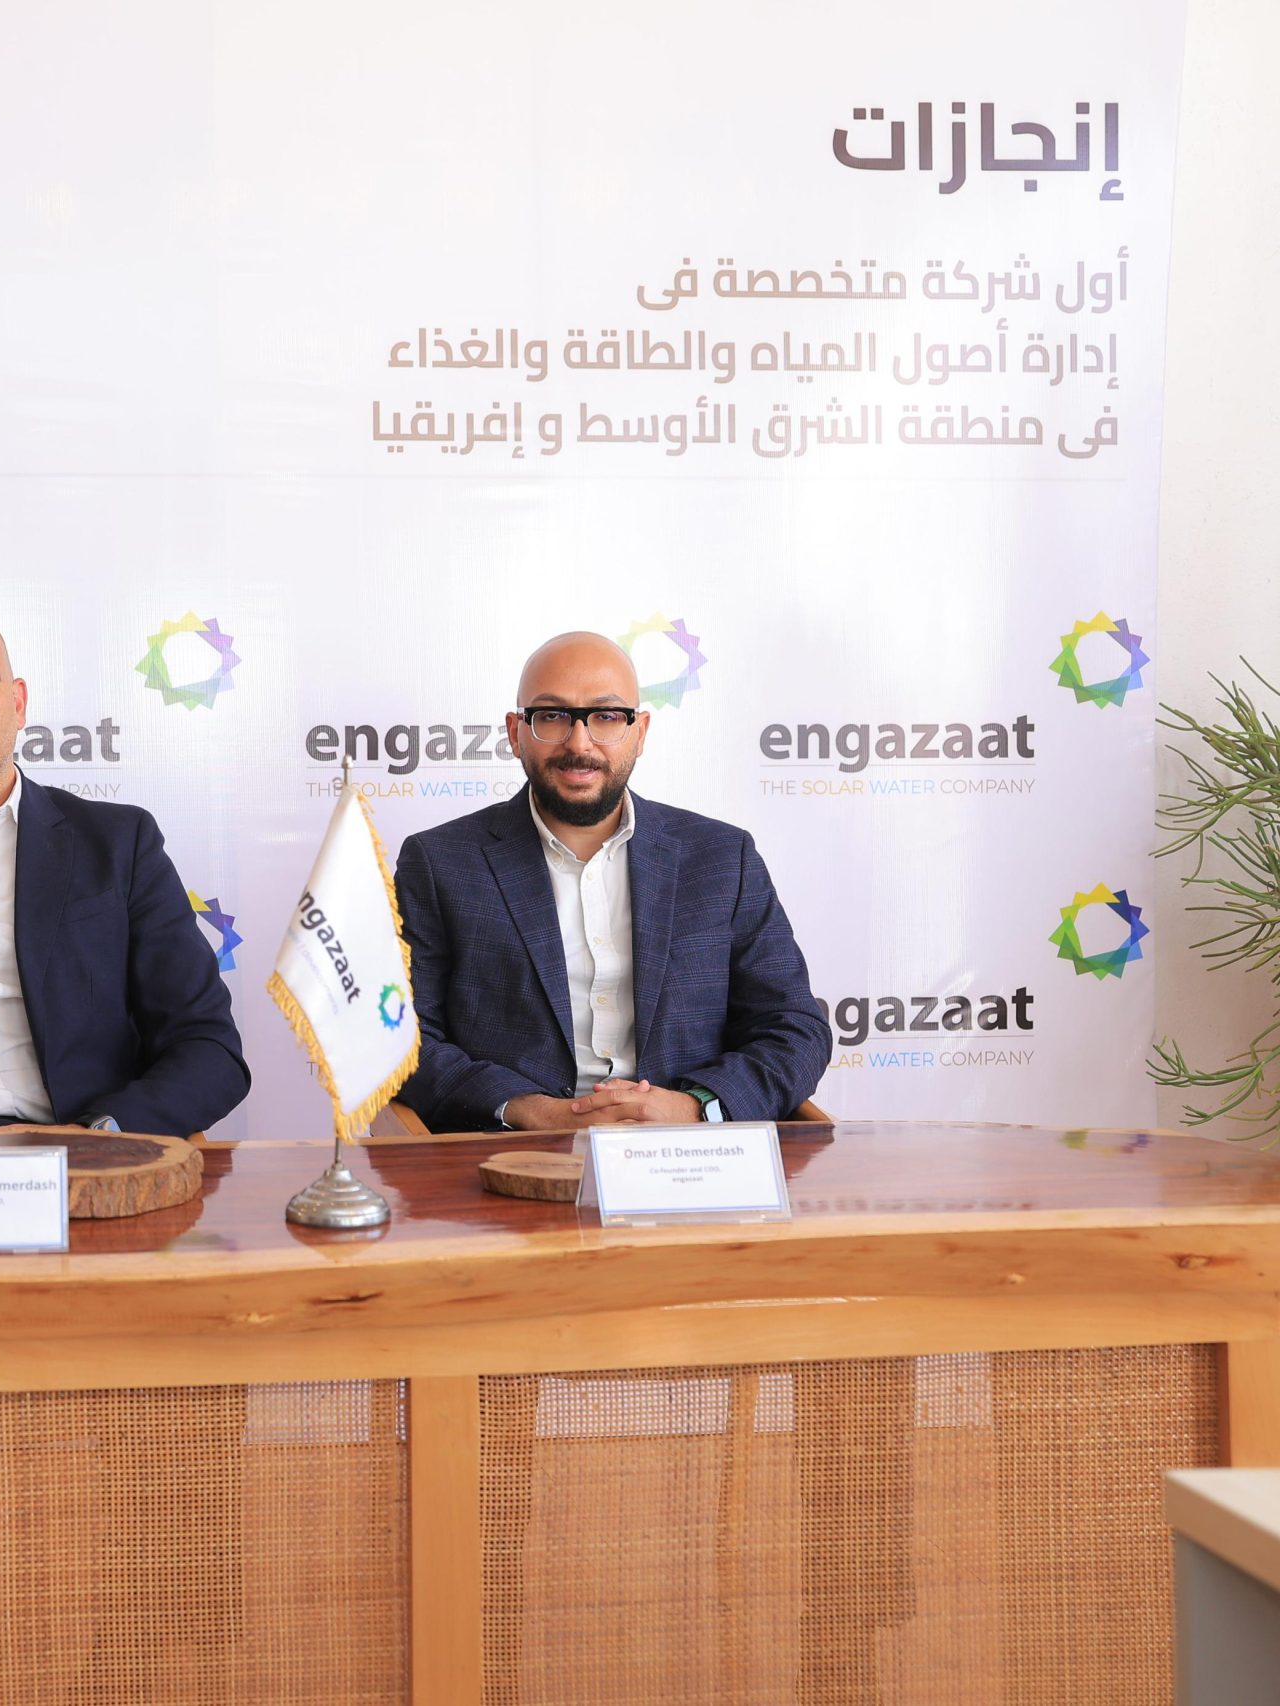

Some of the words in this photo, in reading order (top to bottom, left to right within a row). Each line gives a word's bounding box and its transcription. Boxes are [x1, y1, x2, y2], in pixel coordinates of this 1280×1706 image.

[832, 102, 1123, 200] إنجازات
[713, 258, 906, 299] متخصصة
[922, 253, 1040, 314] شركة
[1056, 245, 1129, 314] أول
[388, 328, 548, 382] والغذاء
[563, 329, 735, 384] والطاقة
[751, 331, 876, 383] المياه
[893, 317, 1008, 385] أصول
[1022, 333, 1119, 389] إدارة
[373, 401, 524, 459] إفريقيا
[577, 395, 736, 456] الأوسط
[752, 397, 882, 459] الشرق
[899, 405, 1043, 446] منطقة
[305, 724, 516, 775] engaz
[759, 715, 1035, 773] engazaat
[352, 782, 414, 797] OLAR
[419, 781, 487, 797] WATER
[760, 780, 796, 795] THE
[802, 780, 864, 795] SOLAR
[870, 779, 936, 795] WATER
[940, 779, 1036, 794] COMPANY
[298, 890, 361, 1004] ngazaat
[816, 987, 1034, 1046] gazaat
[869, 1052, 934, 1068] WATER
[939, 1050, 1034, 1067] COMPANY
[624, 1147, 658, 1159] Omar
[662, 1147, 672, 1158] El
[675, 1145, 744, 1158] Demerdash
